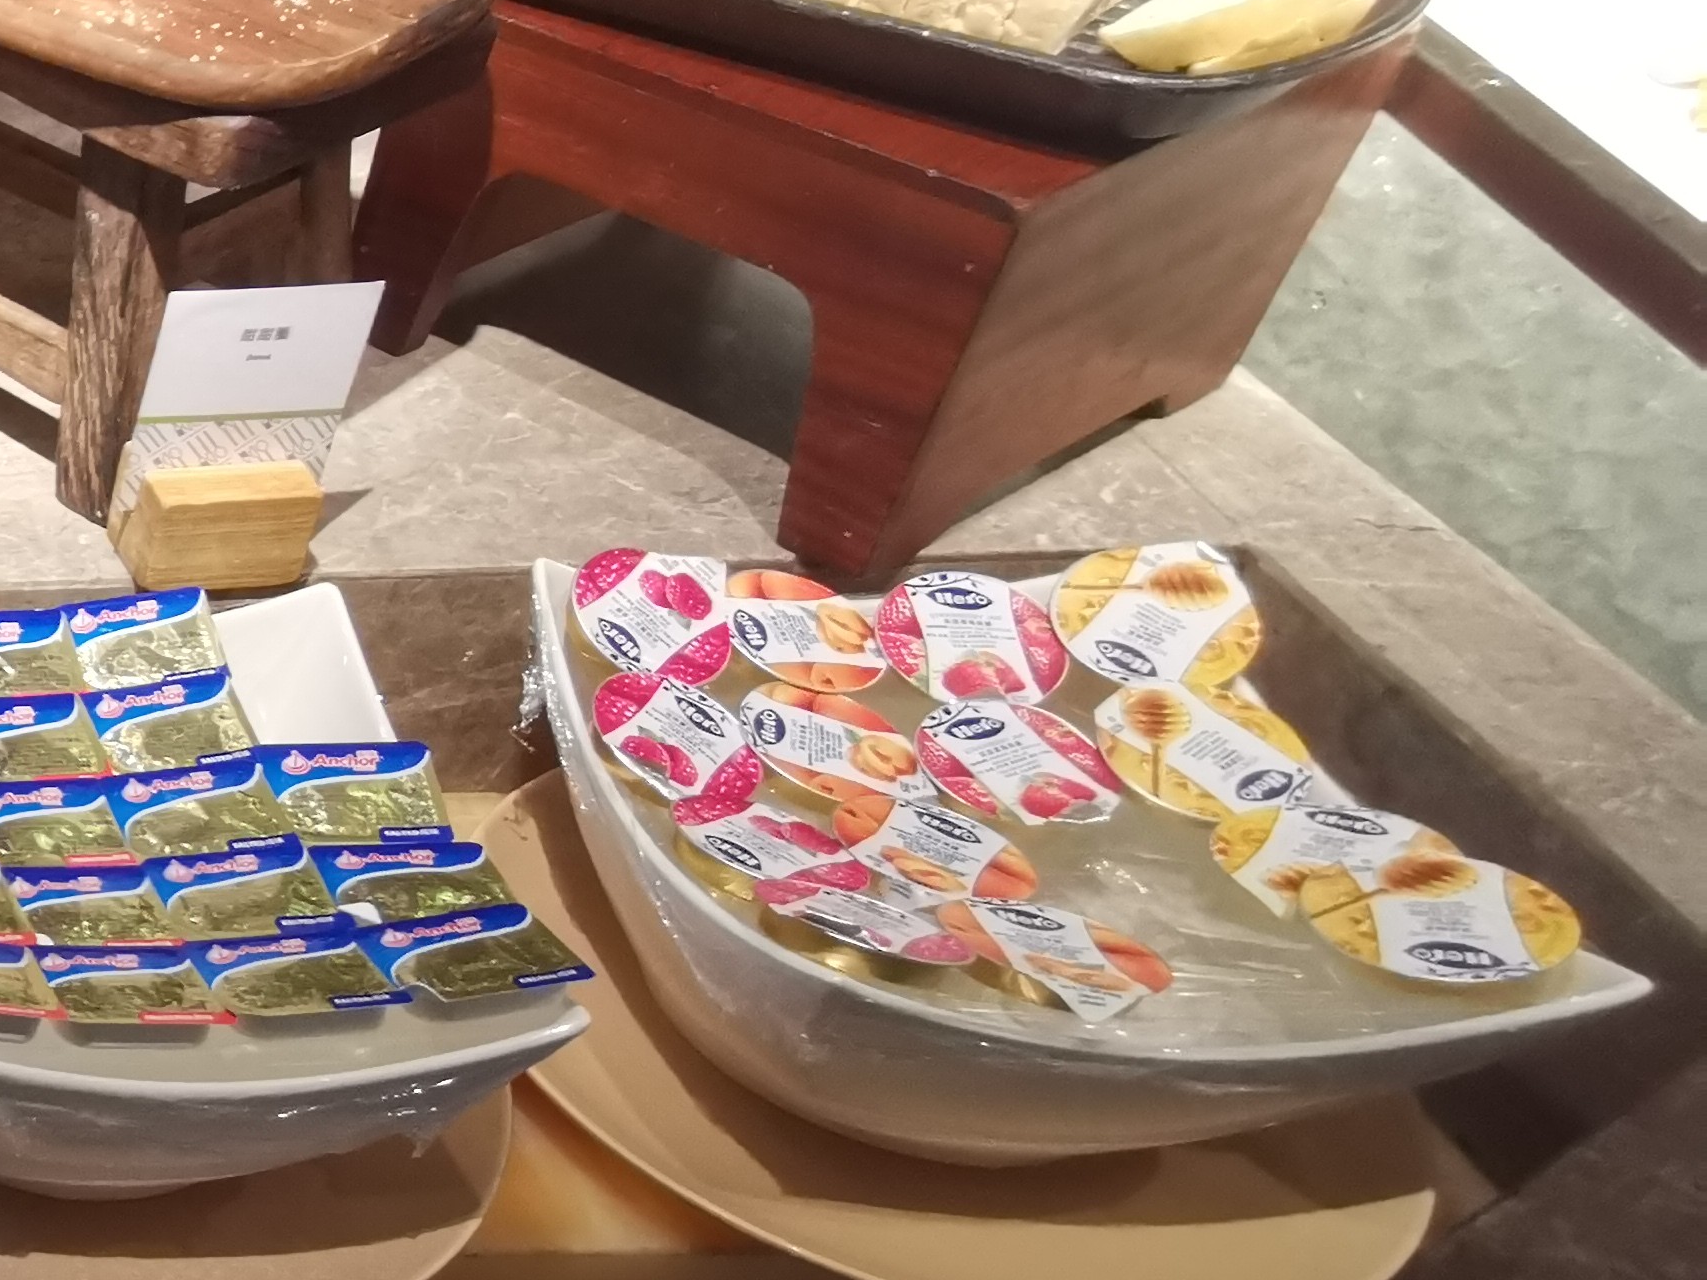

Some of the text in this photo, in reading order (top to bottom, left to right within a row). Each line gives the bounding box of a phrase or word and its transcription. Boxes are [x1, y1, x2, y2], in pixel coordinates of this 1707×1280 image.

[934, 591, 989, 606] Hero
[98, 603, 160, 623] Anchor
[737, 611, 766, 646] Hero
[600, 621, 640, 658] Hero
[124, 687, 185, 707] Anchor
[759, 709, 778, 745] Hero
[950, 719, 1002, 739] Hero
[312, 753, 379, 770] Anchor
[920, 814, 978, 842] Hero
[994, 907, 1060, 930] Hero
[1411, 947, 1493, 967] Hero
